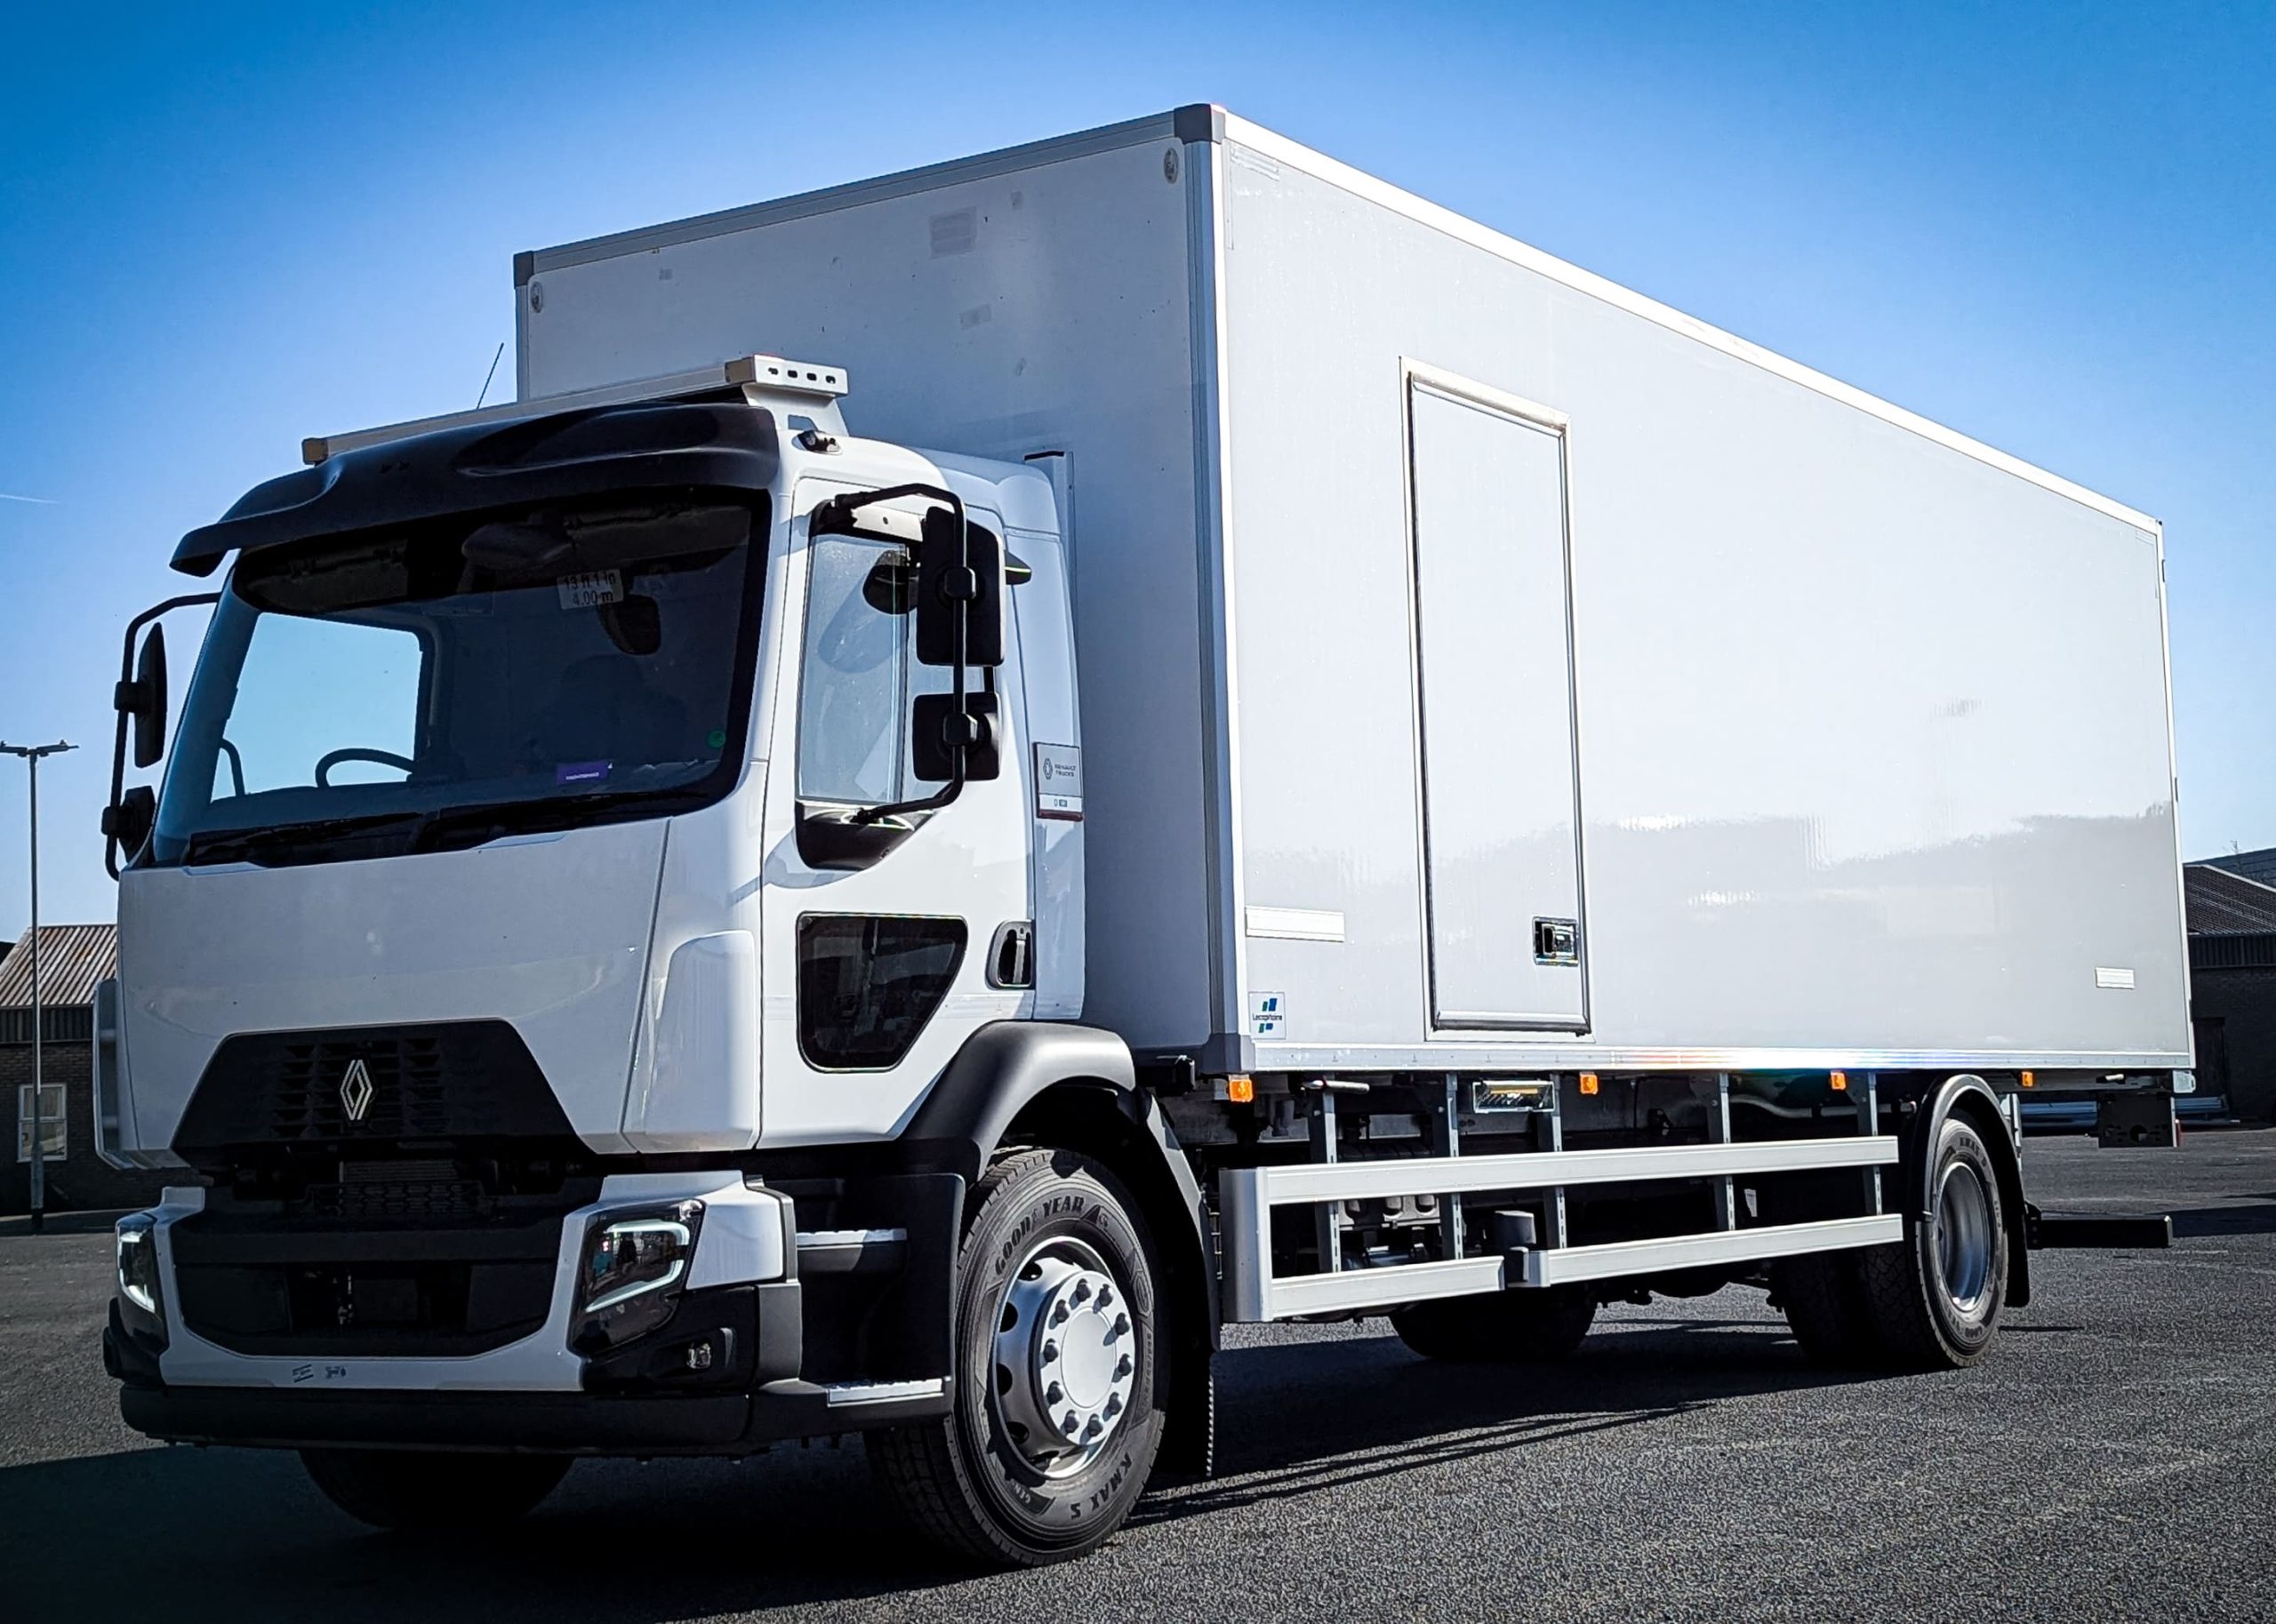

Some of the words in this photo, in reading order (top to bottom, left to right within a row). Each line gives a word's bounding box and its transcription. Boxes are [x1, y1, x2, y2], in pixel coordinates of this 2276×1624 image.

[563, 575, 579, 590] 13
[573, 589, 598, 606] 4.00
[600, 591, 613, 602] m
[1090, 1452, 1133, 1512] KMAX
[1070, 1502, 1082, 1521] S
